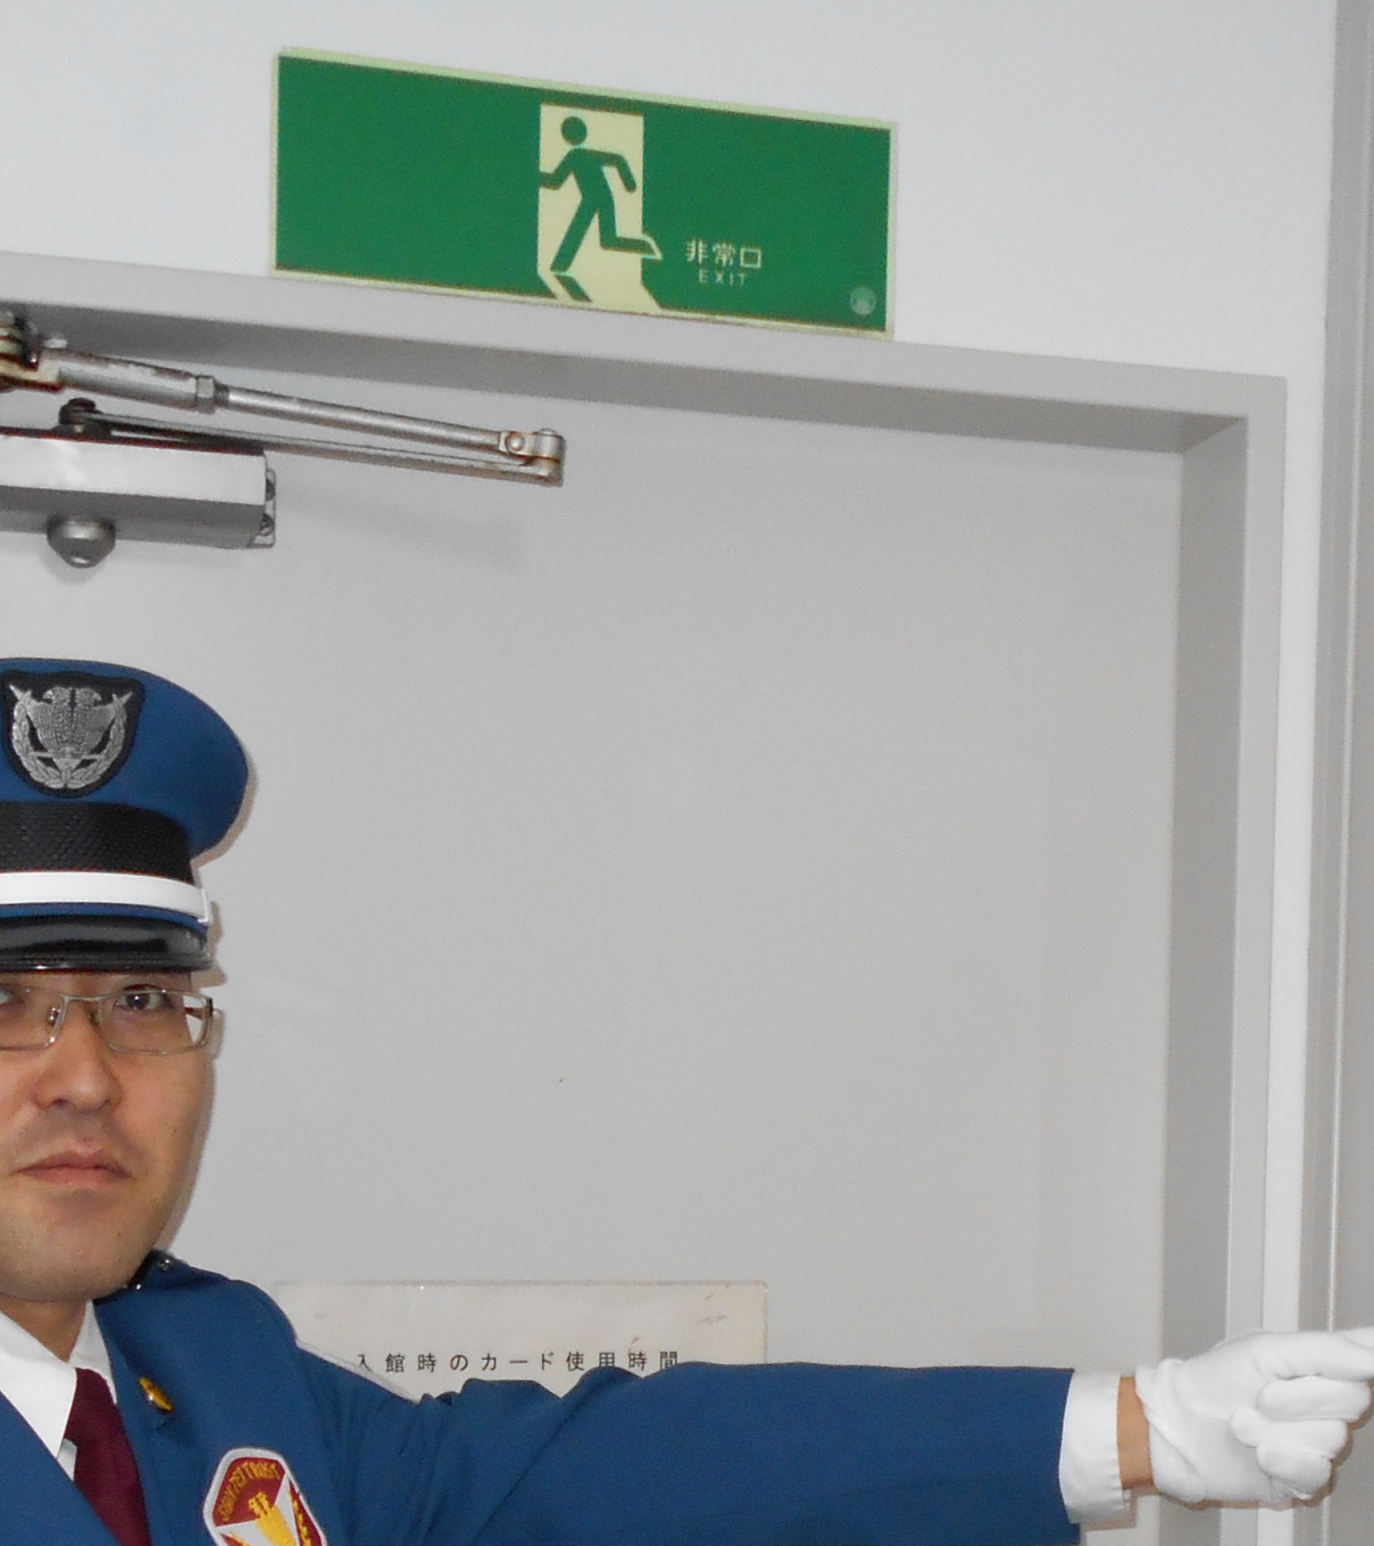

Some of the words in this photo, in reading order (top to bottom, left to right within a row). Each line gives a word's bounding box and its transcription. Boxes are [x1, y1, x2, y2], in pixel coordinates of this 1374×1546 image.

[685, 239, 762, 269] 非常口
[699, 269, 747, 287] EXIT
[356, 1351, 677, 1373] 入館時のカード使用時間
